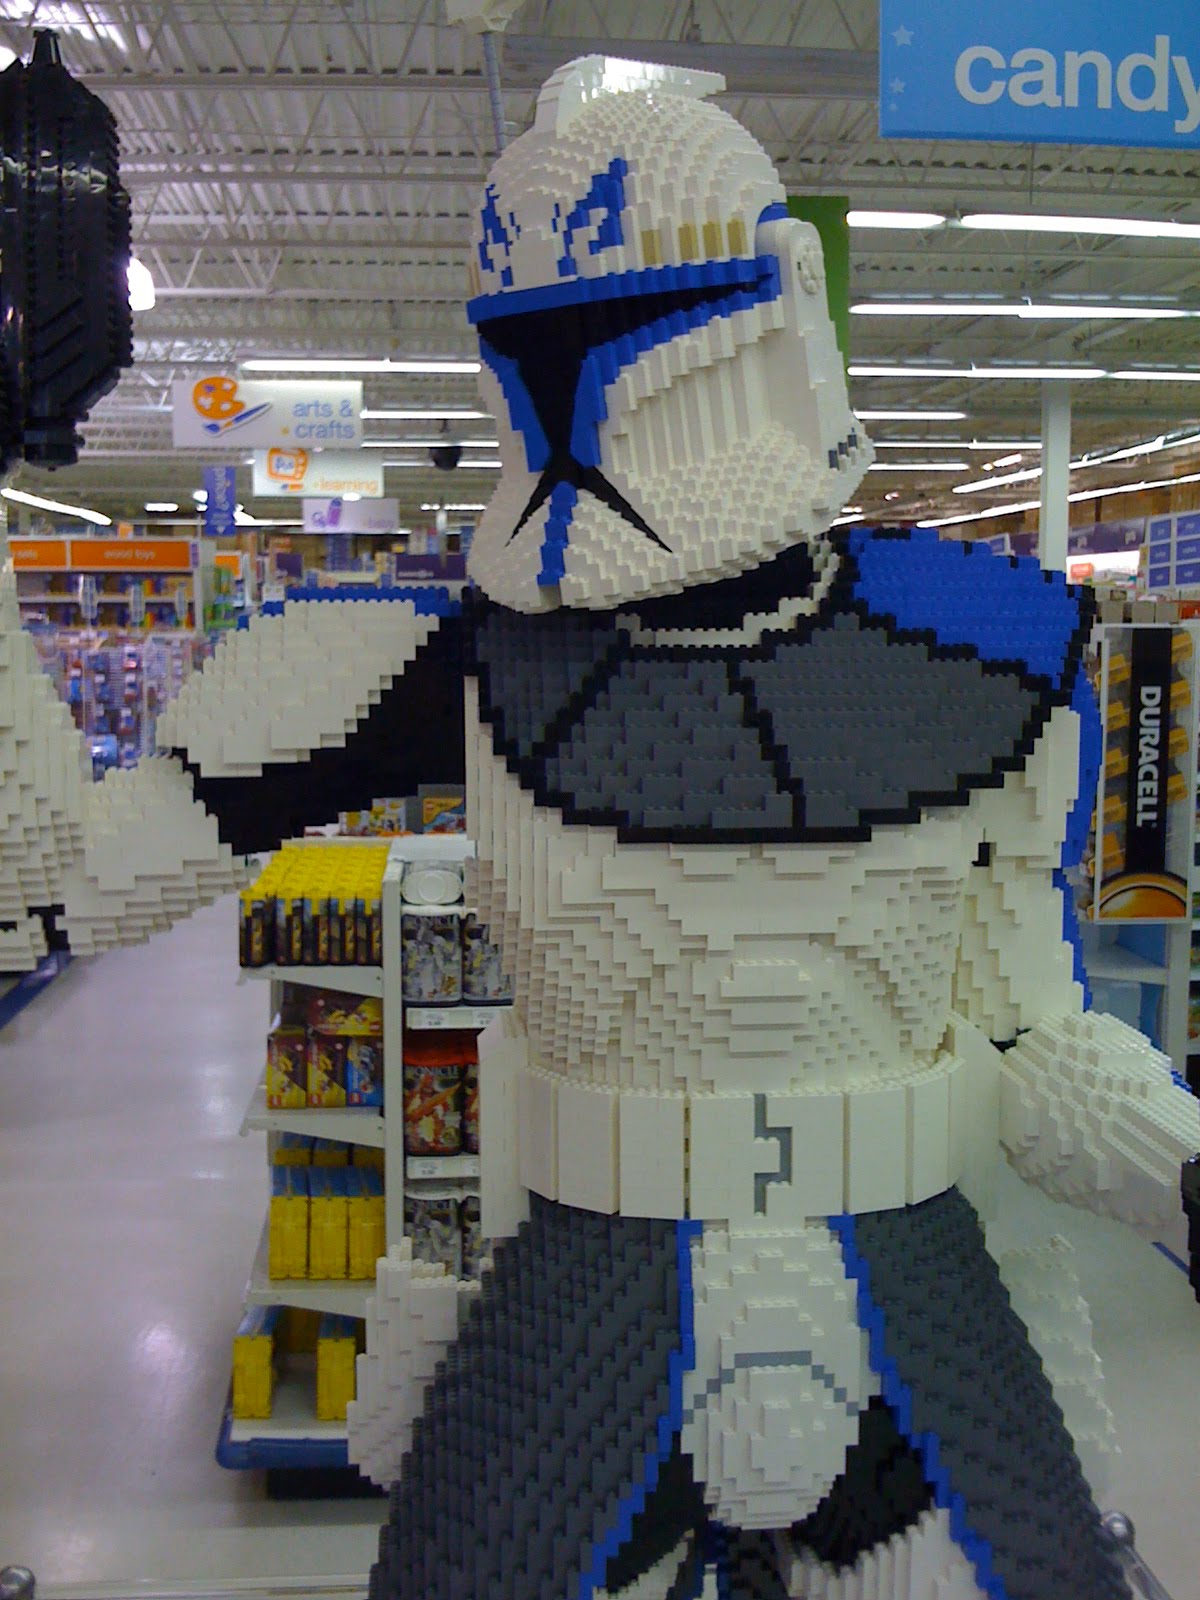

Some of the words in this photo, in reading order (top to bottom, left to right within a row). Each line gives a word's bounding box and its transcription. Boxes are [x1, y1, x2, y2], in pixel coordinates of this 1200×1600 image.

[955, 34, 1200, 134] candy
[292, 400, 332, 417] arts
[340, 399, 353, 417] &
[294, 420, 355, 439] crafts
[320, 478, 378, 495] learning
[1136, 686, 1162, 828] DURACELL
